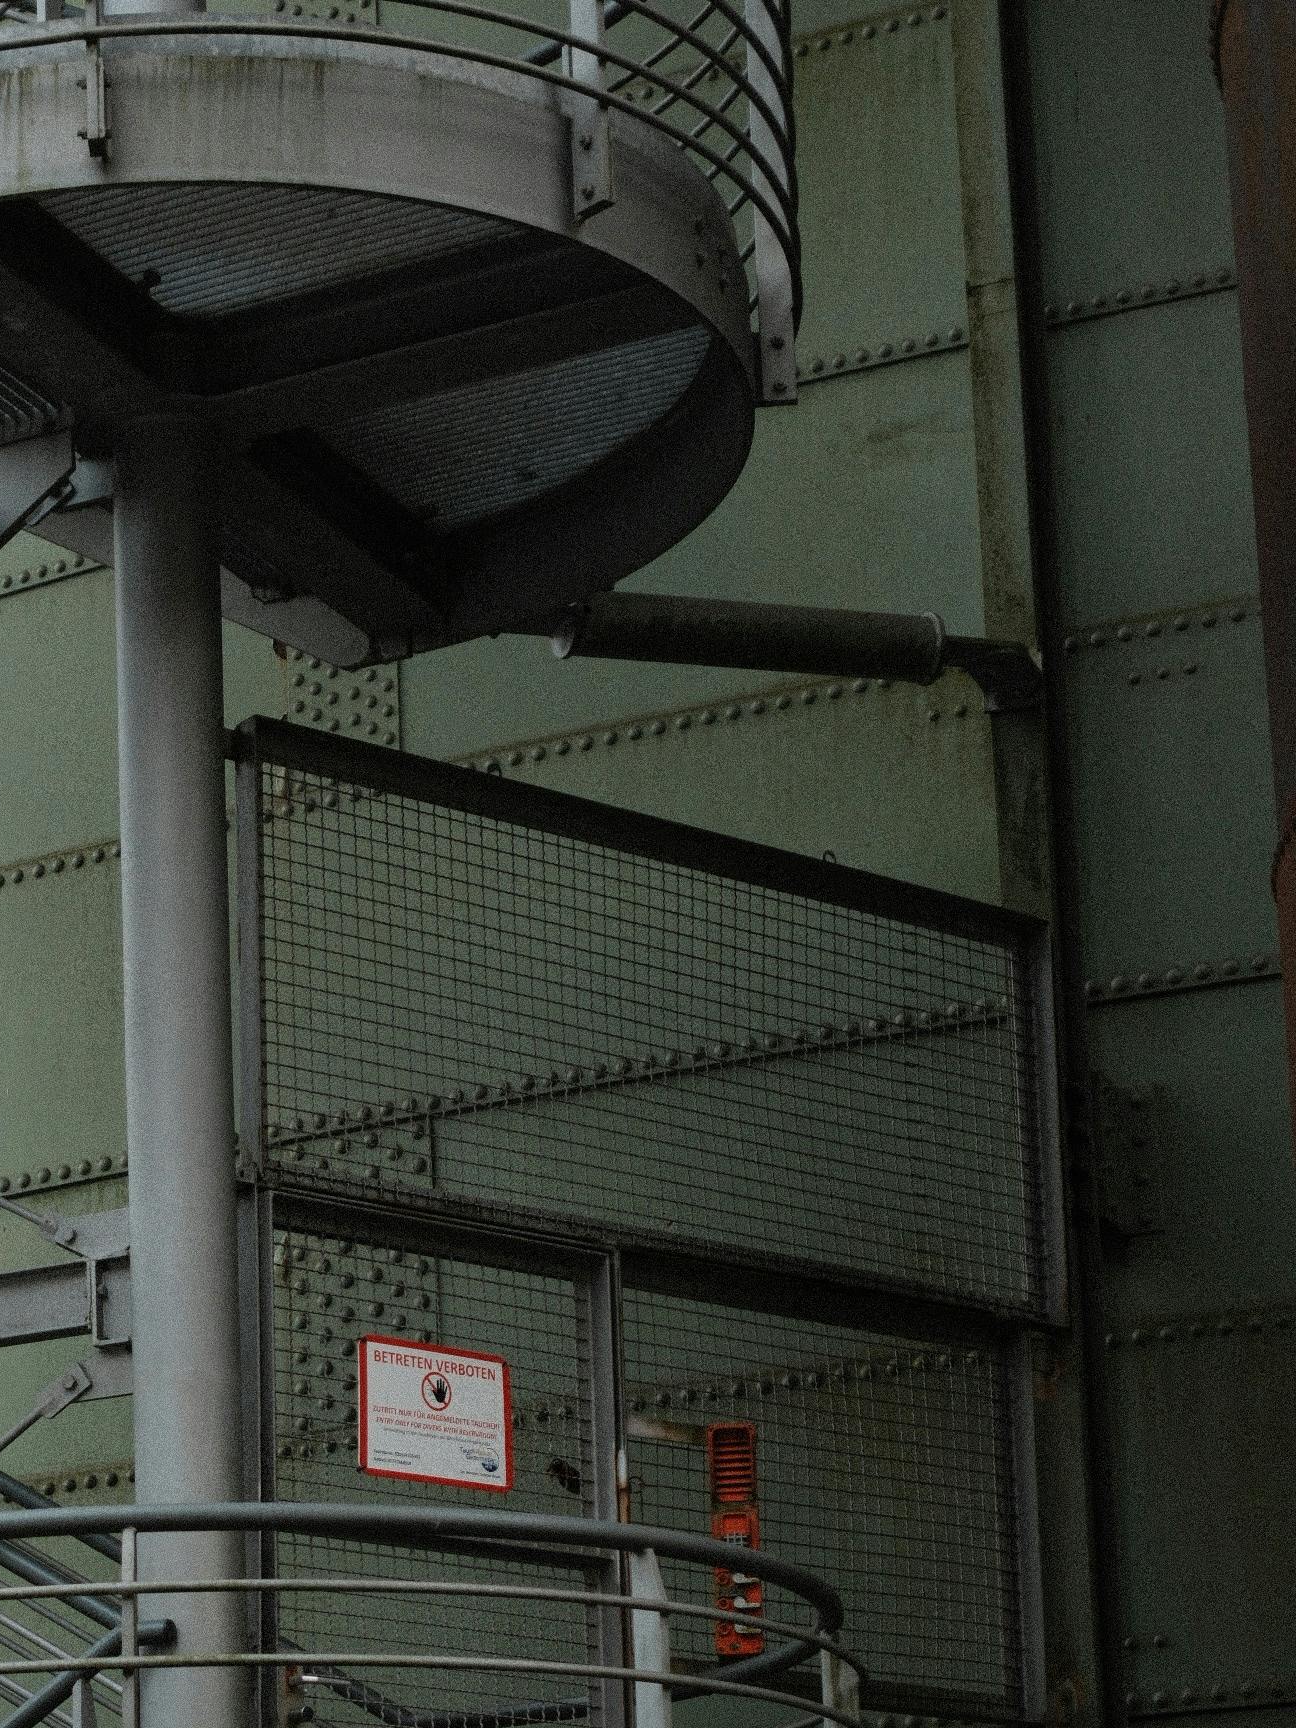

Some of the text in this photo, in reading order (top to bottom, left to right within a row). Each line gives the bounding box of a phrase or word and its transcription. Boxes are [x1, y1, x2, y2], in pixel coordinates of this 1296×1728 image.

[374, 1350, 496, 1381] BETRETEN VERBOTEN
[373, 1405, 397, 1415] ZUTRITT
[398, 1408, 412, 1417] NUR
[413, 1408, 425, 1419] FÜR
[376, 1416, 394, 1424] ENTRY
[395, 1419, 410, 1427] ONLY
[410, 1421, 422, 1429] FOR
[422, 1423, 442, 1432] DIVERS
